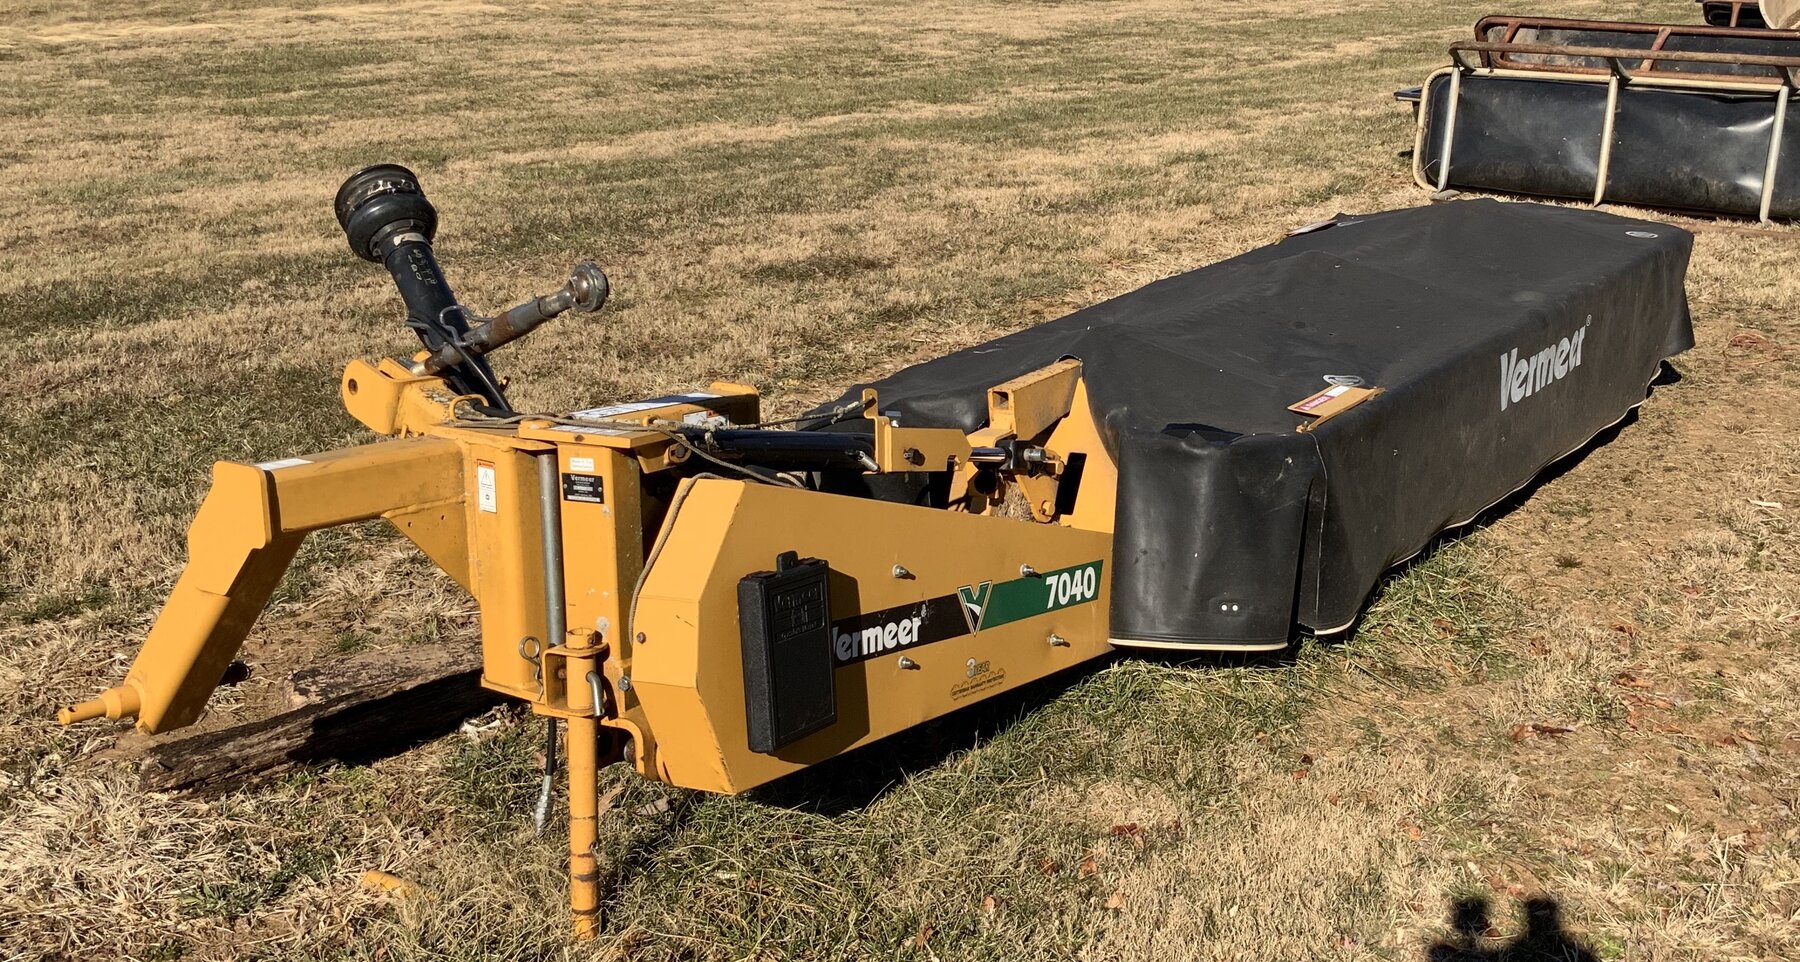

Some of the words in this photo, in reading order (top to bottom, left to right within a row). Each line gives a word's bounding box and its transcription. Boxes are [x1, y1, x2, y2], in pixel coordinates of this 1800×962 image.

[1501, 326, 1586, 412] Vermeer
[571, 474, 595, 483] Vermeer
[1045, 566, 1096, 609] 7040
